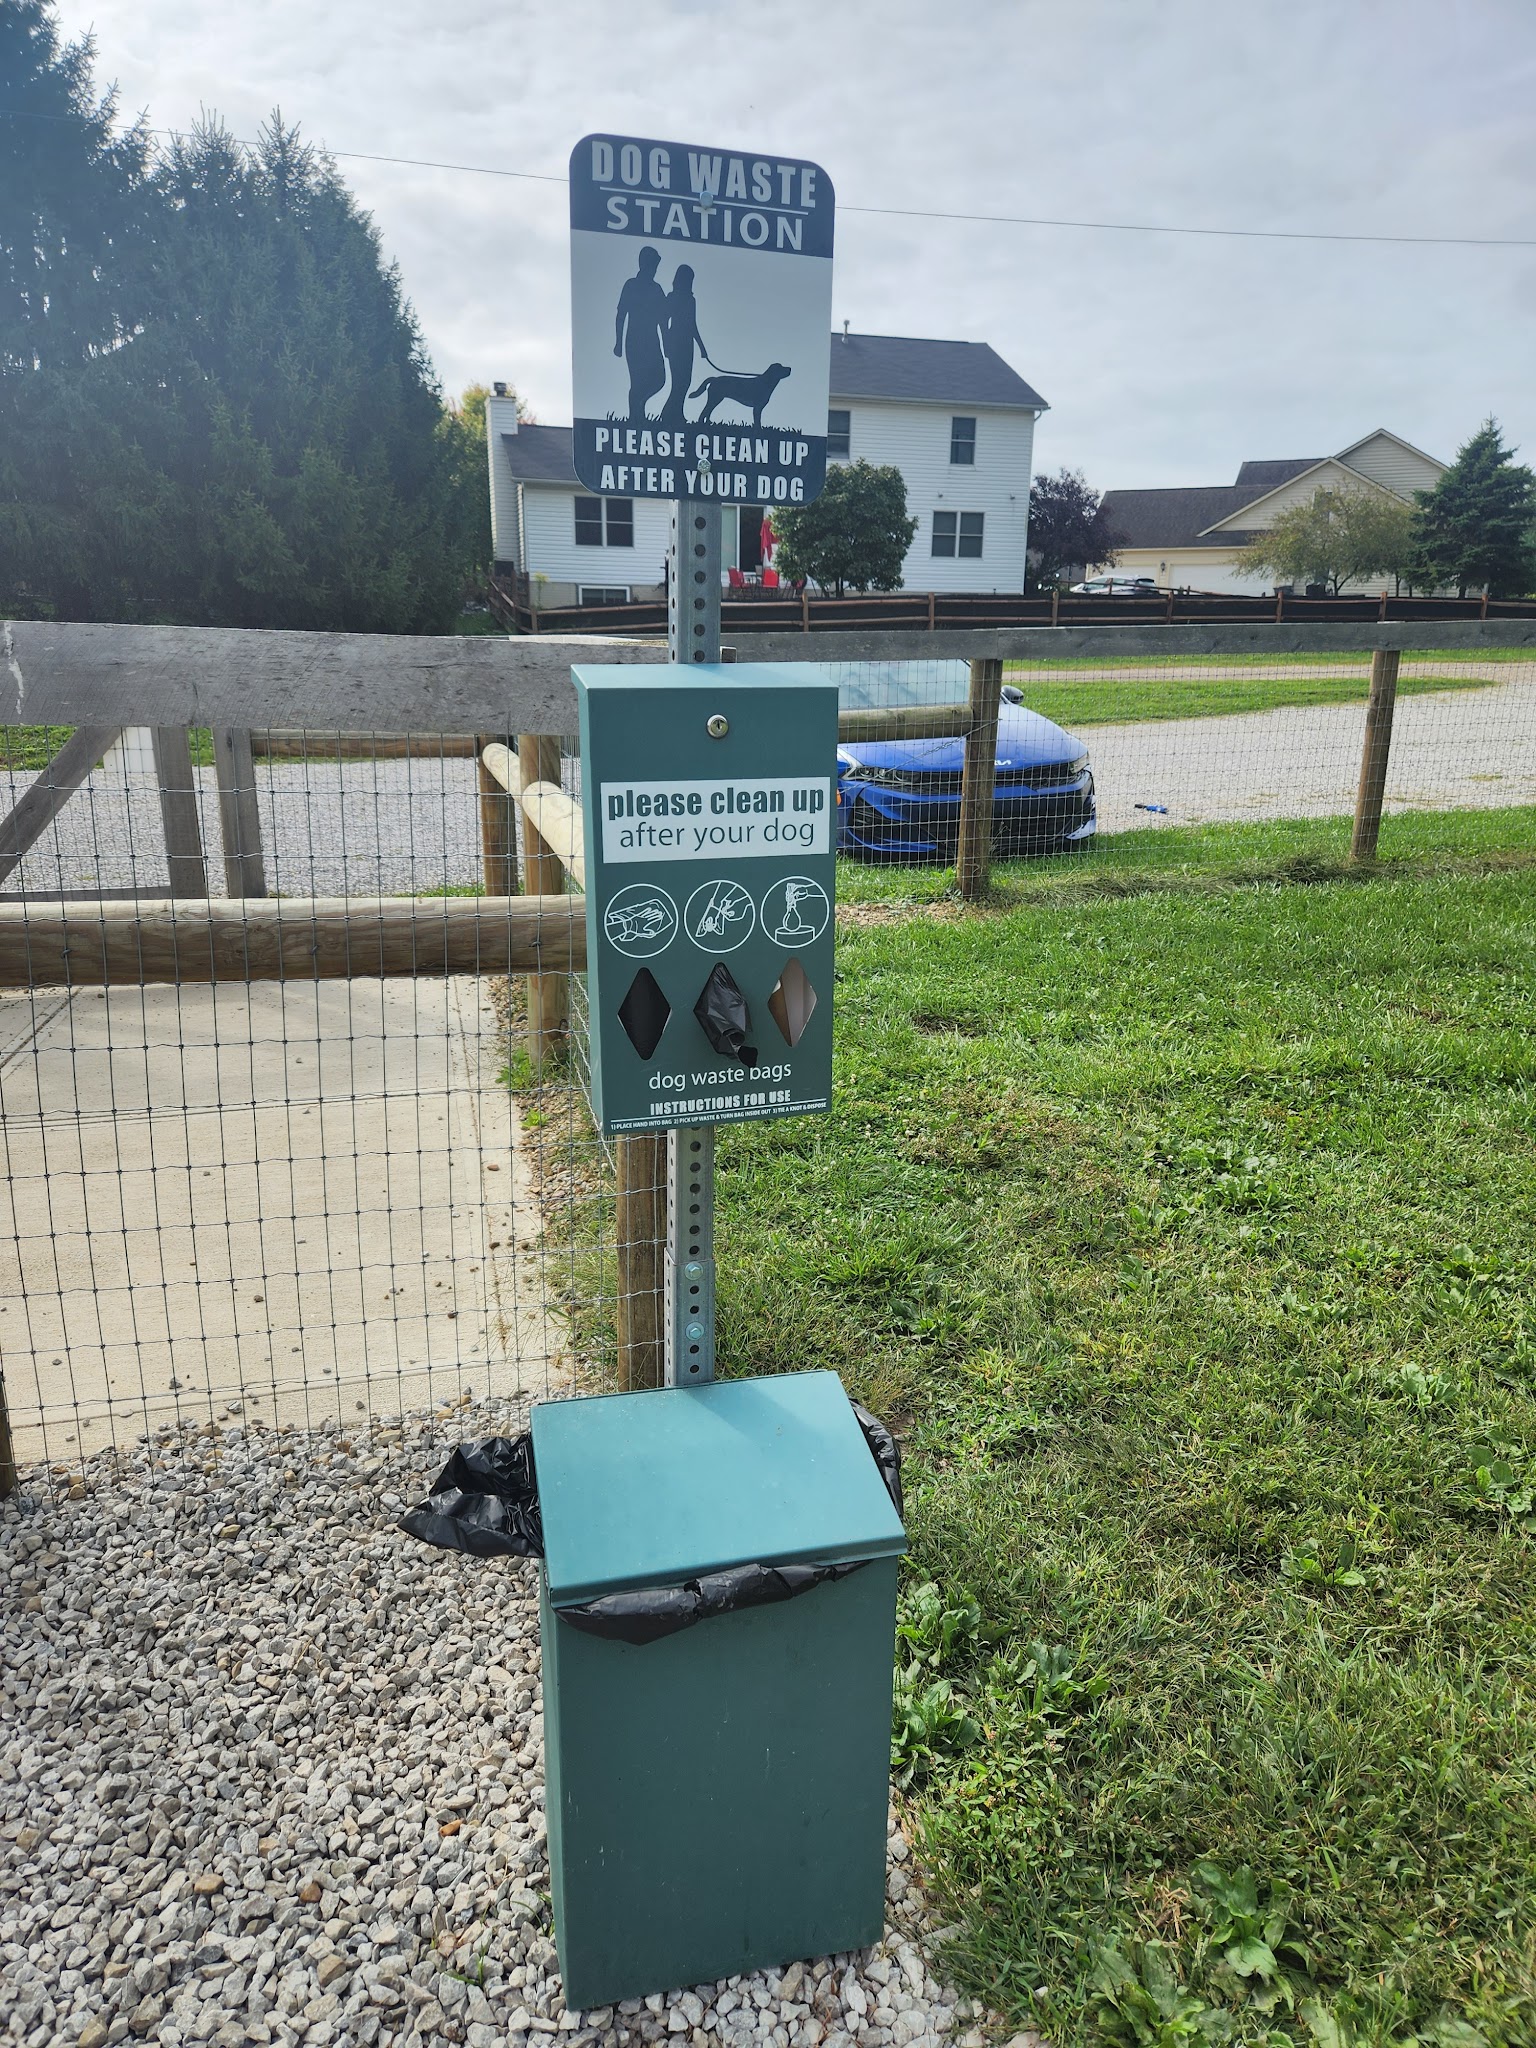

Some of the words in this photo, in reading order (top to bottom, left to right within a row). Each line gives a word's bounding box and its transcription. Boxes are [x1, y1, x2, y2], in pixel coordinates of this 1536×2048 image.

[591, 140, 671, 190] DOG
[688, 152, 817, 208] WASTE
[606, 196, 803, 251] STATION
[595, 427, 685, 458] PLEASE
[695, 434, 769, 464] CLEAN
[779, 440, 809, 466] UP
[601, 464, 675, 493] AFTER
[685, 469, 747, 498] YOUR
[757, 475, 804, 501] DOG
[608, 789, 702, 821] please
[710, 787, 785, 815] clean
[792, 788, 824, 814] up
[620, 821, 685, 848] after
[693, 824, 755, 852] your
[763, 817, 814, 847] dog
[648, 1071, 686, 1092] dog
[691, 1067, 744, 1086] waste
[749, 1063, 792, 1082] bags
[650, 1095, 740, 1115] INSTRUCTIONS
[743, 1092, 765, 1107] FOR
[768, 1089, 791, 1104] USE
